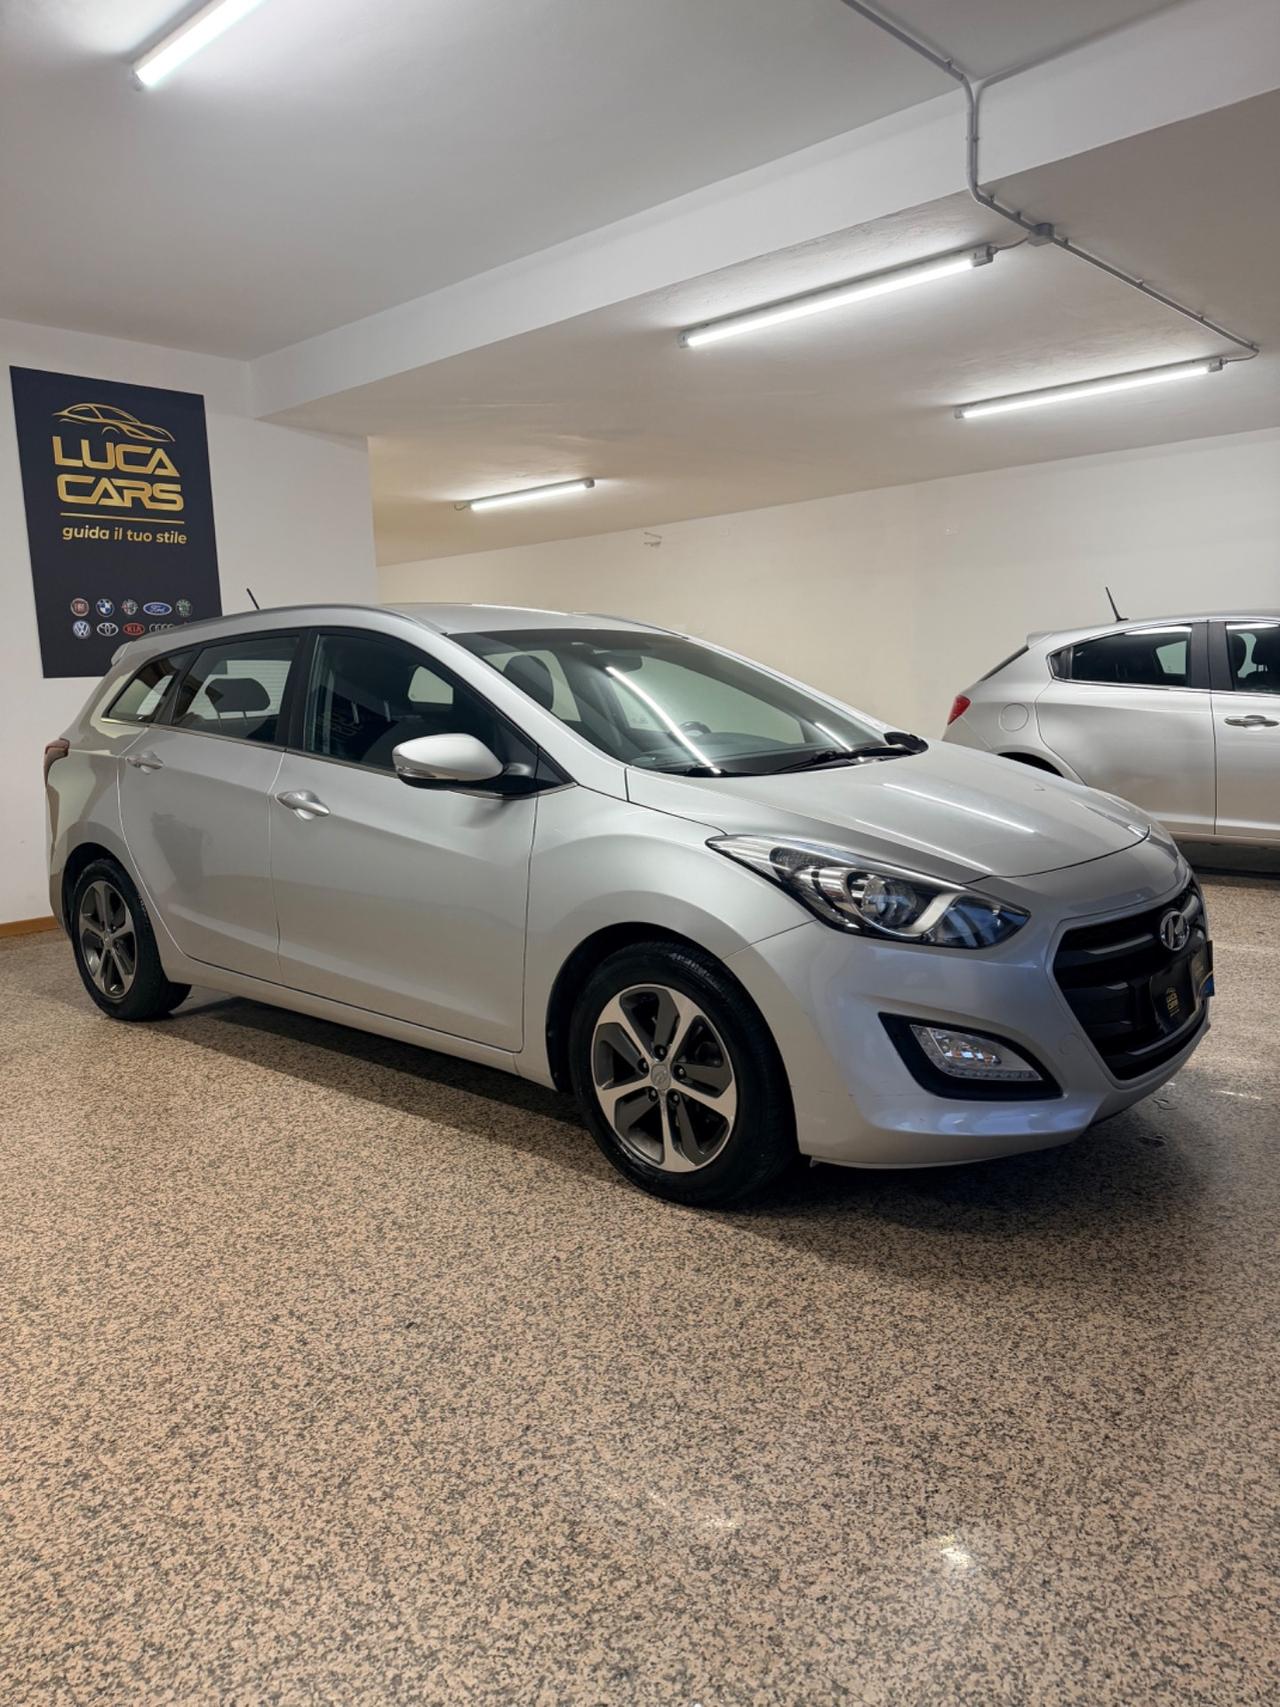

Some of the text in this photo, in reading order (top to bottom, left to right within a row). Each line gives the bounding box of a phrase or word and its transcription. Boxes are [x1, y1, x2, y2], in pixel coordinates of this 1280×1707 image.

[53, 436, 180, 477] LUCA
[57, 474, 184, 511] CARS
[62, 525, 187, 544] guida il tuo stile
